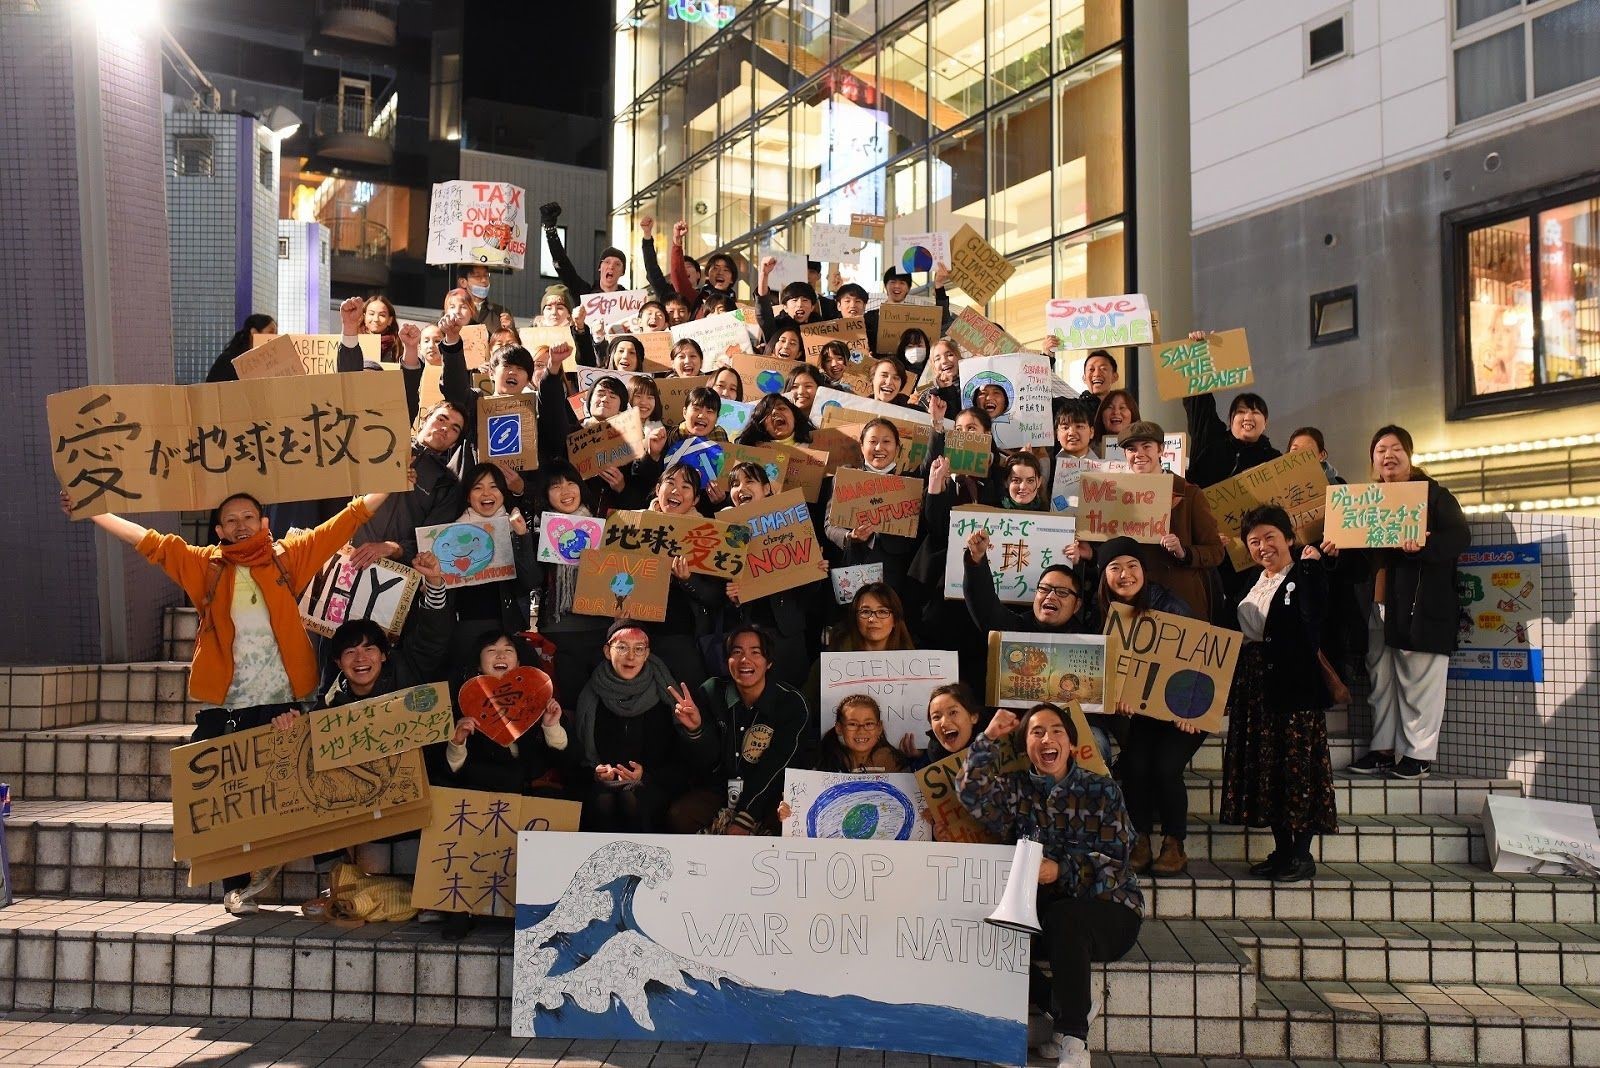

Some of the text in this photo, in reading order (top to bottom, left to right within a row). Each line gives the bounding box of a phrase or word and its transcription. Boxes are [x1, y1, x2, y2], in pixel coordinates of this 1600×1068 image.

[473, 184, 521, 208] TAX
[466, 207, 506, 222] ONLY
[954, 250, 999, 292] CLIMATE
[967, 237, 1009, 282] GLOBAL
[950, 265, 985, 301] TRIKE
[586, 295, 618, 316] Stop
[803, 320, 863, 337] OXYGEN HAS
[1053, 319, 1149, 351] HOME
[808, 345, 824, 356] LEF
[1159, 340, 1209, 368] SAVE
[1175, 357, 1215, 378] THE
[1188, 366, 1251, 395] PLANET
[1061, 459, 1082, 469] Heal
[1085, 459, 1102, 469] the
[835, 475, 906, 503] IMAGINE
[1081, 478, 1156, 505] WE are
[1206, 450, 1317, 510] SAVE THE EARTH
[856, 498, 922, 526] FUTURE
[869, 497, 885, 505] the
[1331, 485, 1384, 511] グローバル
[749, 503, 810, 538] IMATE
[957, 517, 1035, 537] みんなで
[1086, 509, 1168, 537] the world
[1341, 504, 1426, 529] 気候マーチで
[605, 522, 745, 577] 地球を愛そう
[762, 531, 795, 545] changing
[586, 550, 660, 580] SAVE
[746, 537, 812, 578] NOW
[575, 597, 606, 613] OUR
[1107, 610, 1158, 655] NO
[1154, 622, 1231, 669] PLAN
[829, 658, 942, 683] SCIENCE
[866, 683, 908, 696] NOT
[317, 696, 399, 734] みんなで
[482, 682, 524, 726] 愛
[188, 731, 275, 791] SAVE
[220, 776, 249, 793] THE
[188, 782, 279, 834] EARTH
[1523, 834, 1593, 850] HOWELL
[750, 850, 894, 902] STOP
[433, 872, 516, 916] 未来
[681, 911, 1031, 976] WAR ON NATURE
